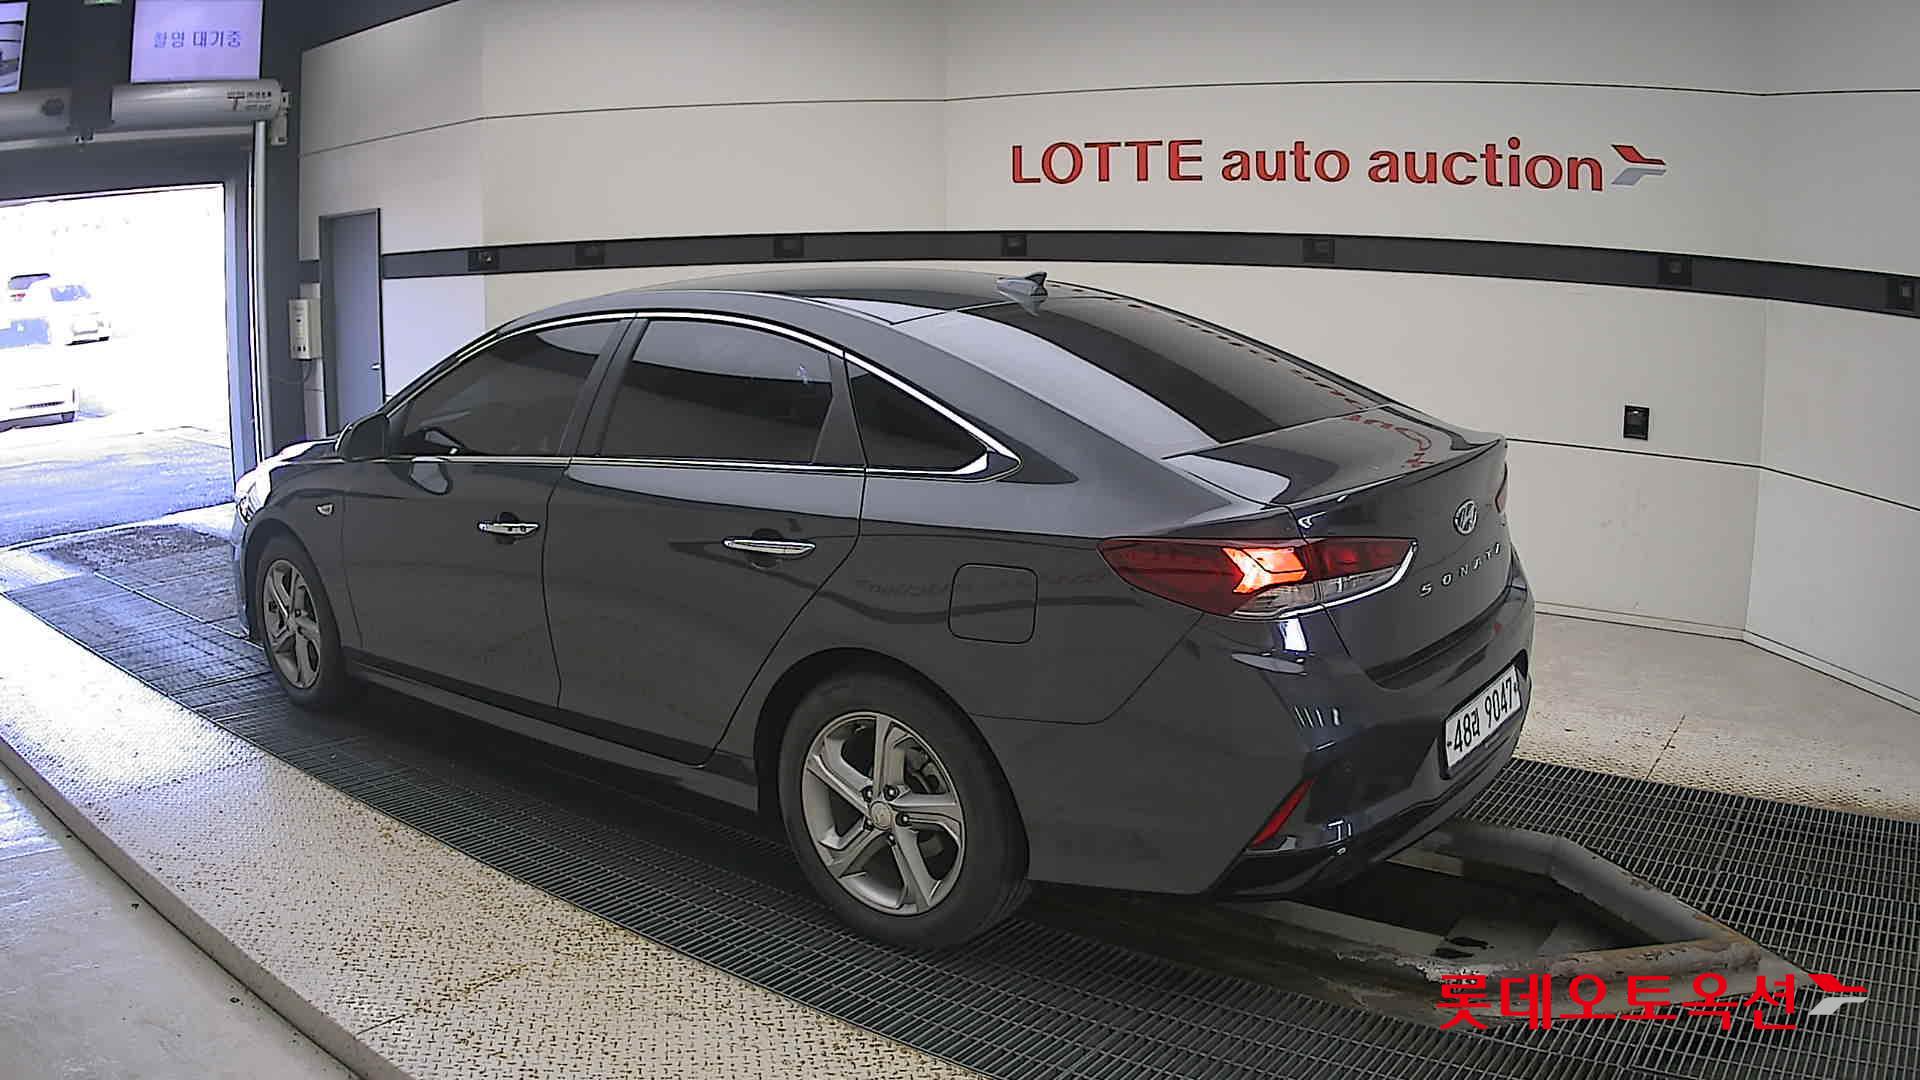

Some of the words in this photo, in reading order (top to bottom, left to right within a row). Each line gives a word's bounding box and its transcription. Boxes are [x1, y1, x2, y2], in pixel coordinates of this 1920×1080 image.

[1012, 139, 1202, 183] LOTTE
[1221, 141, 1349, 183] auto
[1368, 136, 1602, 191] auction
[1485, 677, 1514, 728] 9047
